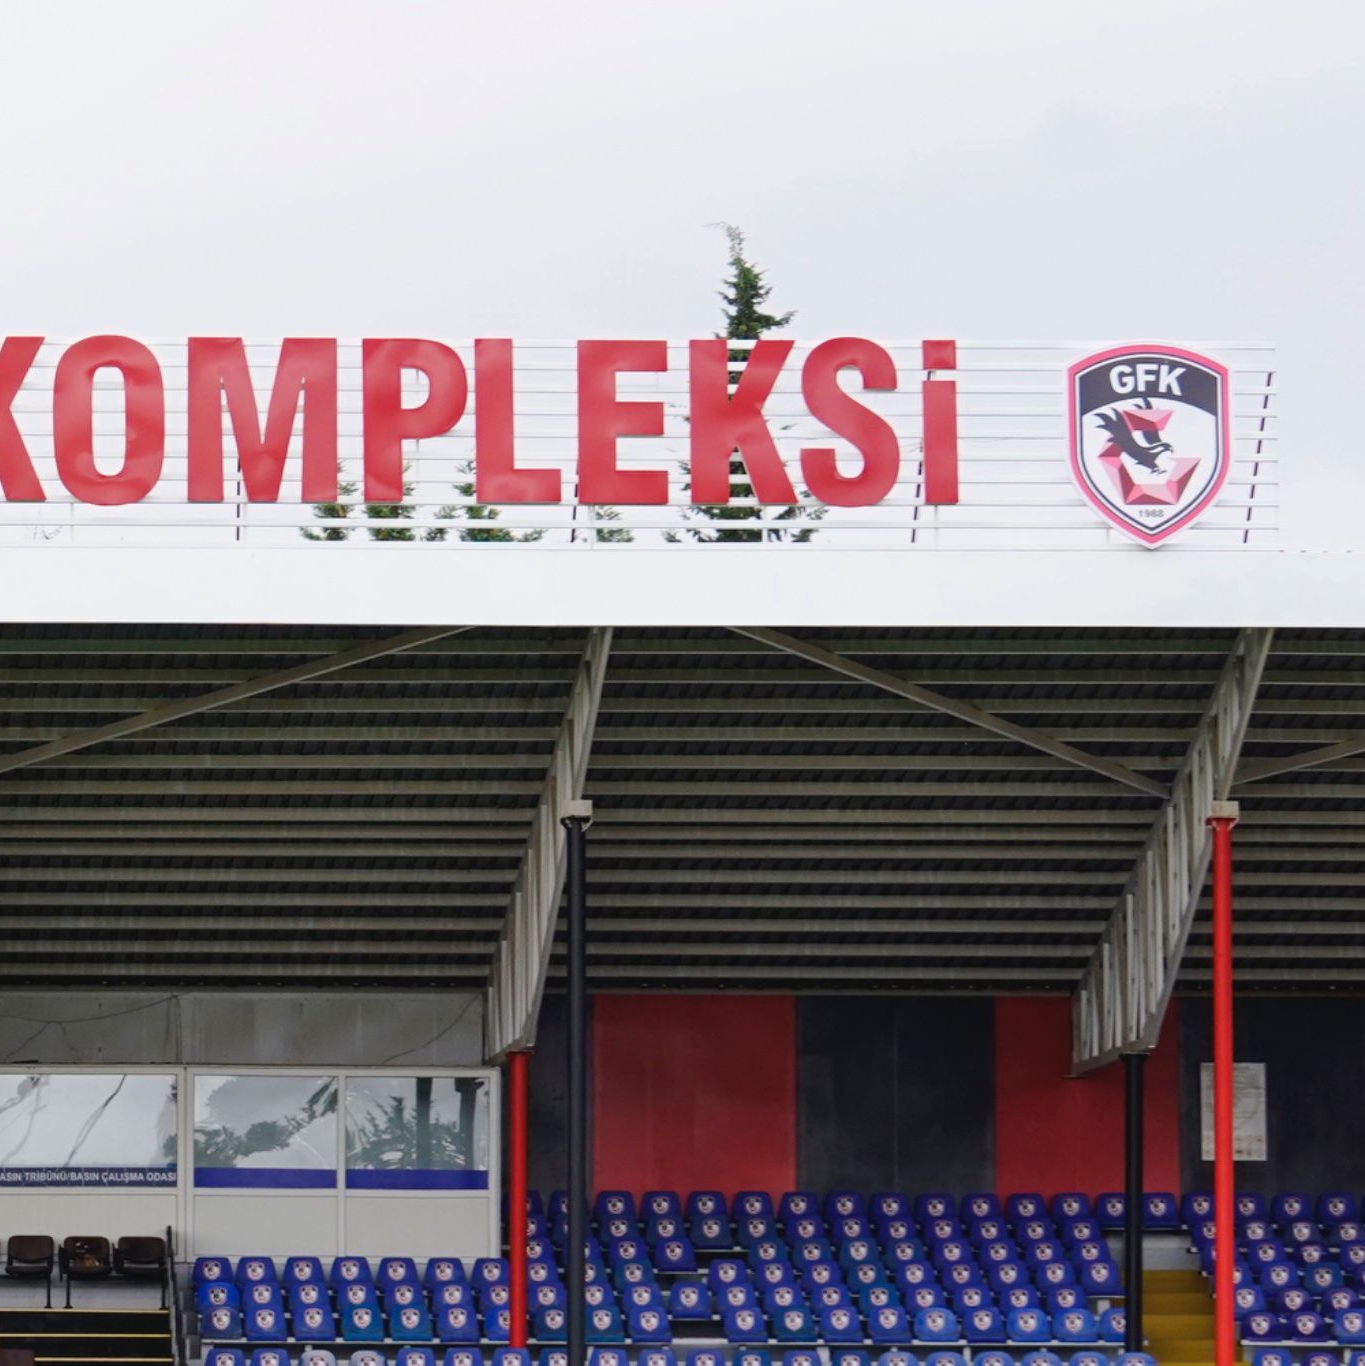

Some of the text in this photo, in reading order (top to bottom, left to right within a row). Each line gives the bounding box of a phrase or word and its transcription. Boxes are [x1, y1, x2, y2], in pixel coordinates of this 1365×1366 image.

[1109, 363, 1187, 396] GFK
[101, 1172, 144, 1184] ÇALIŞMA
[146, 1172, 177, 1182] ODASI
